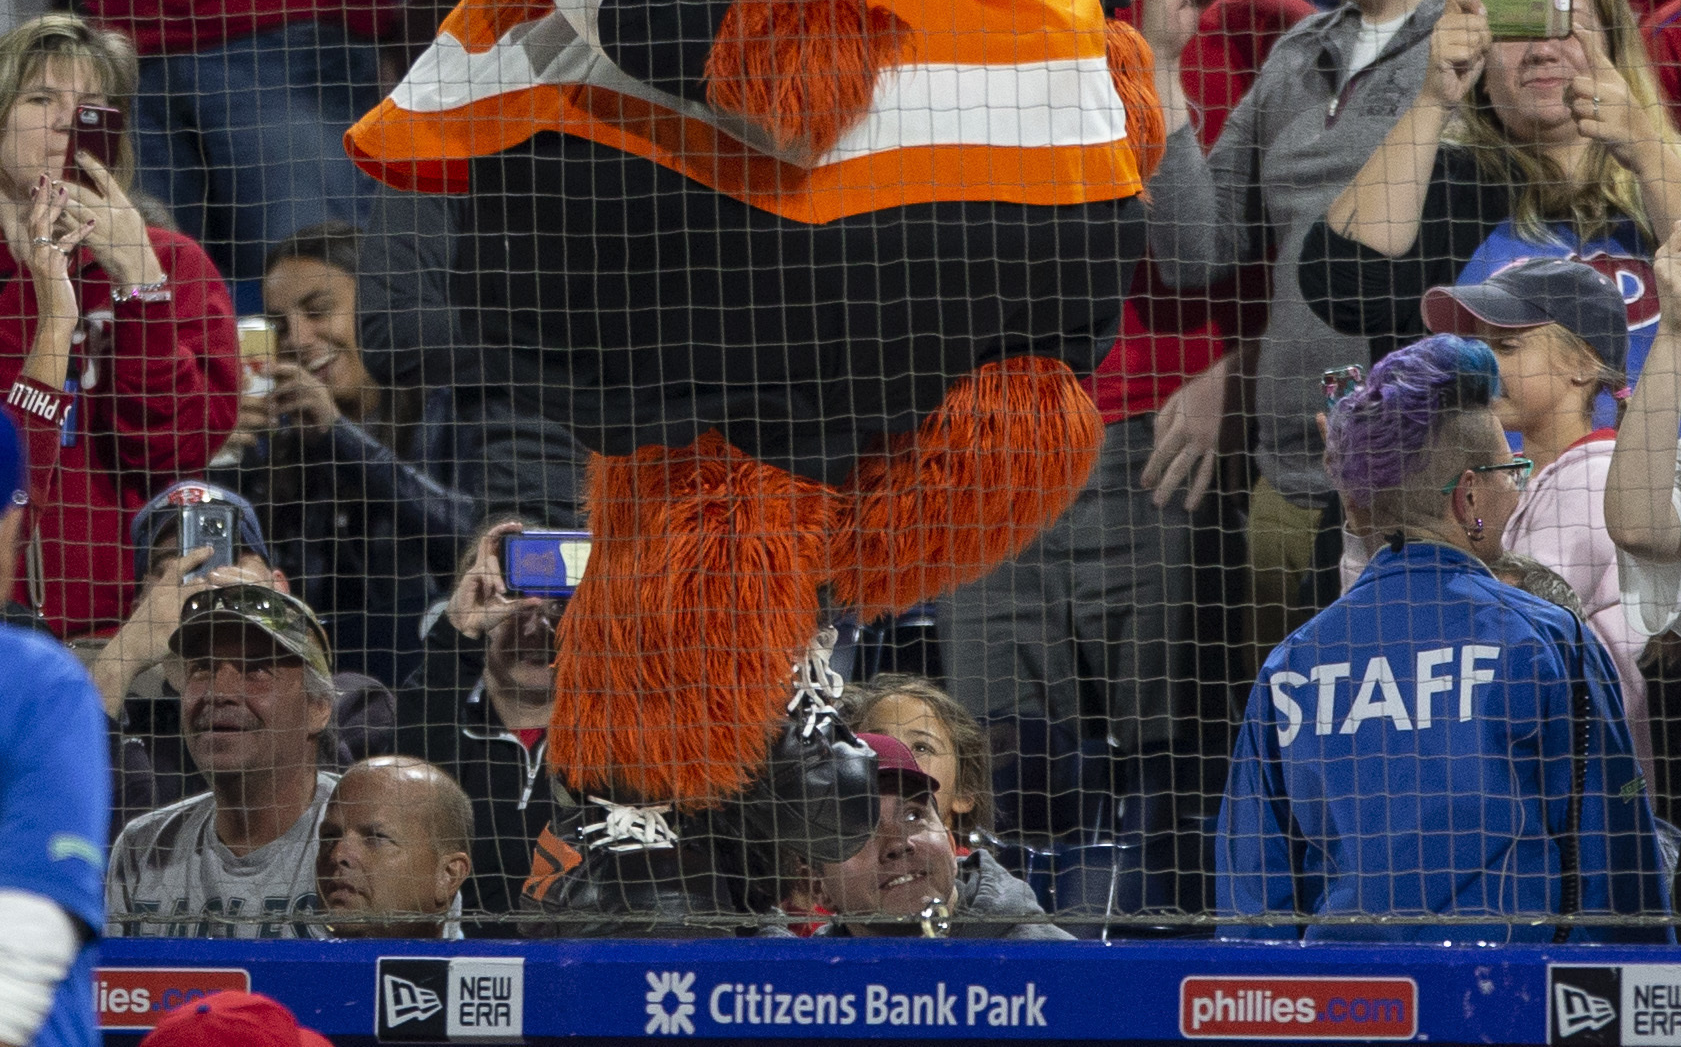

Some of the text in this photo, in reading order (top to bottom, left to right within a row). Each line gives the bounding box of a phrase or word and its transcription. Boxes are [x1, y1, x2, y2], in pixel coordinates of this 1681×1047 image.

[1270, 645, 1500, 747] STAFF
[459, 976, 511, 1000] NEW
[709, 982, 1047, 1026] Citizens Bank Park
[459, 1003, 511, 1027] ERA
[1192, 989, 1405, 1030] phillies.com
